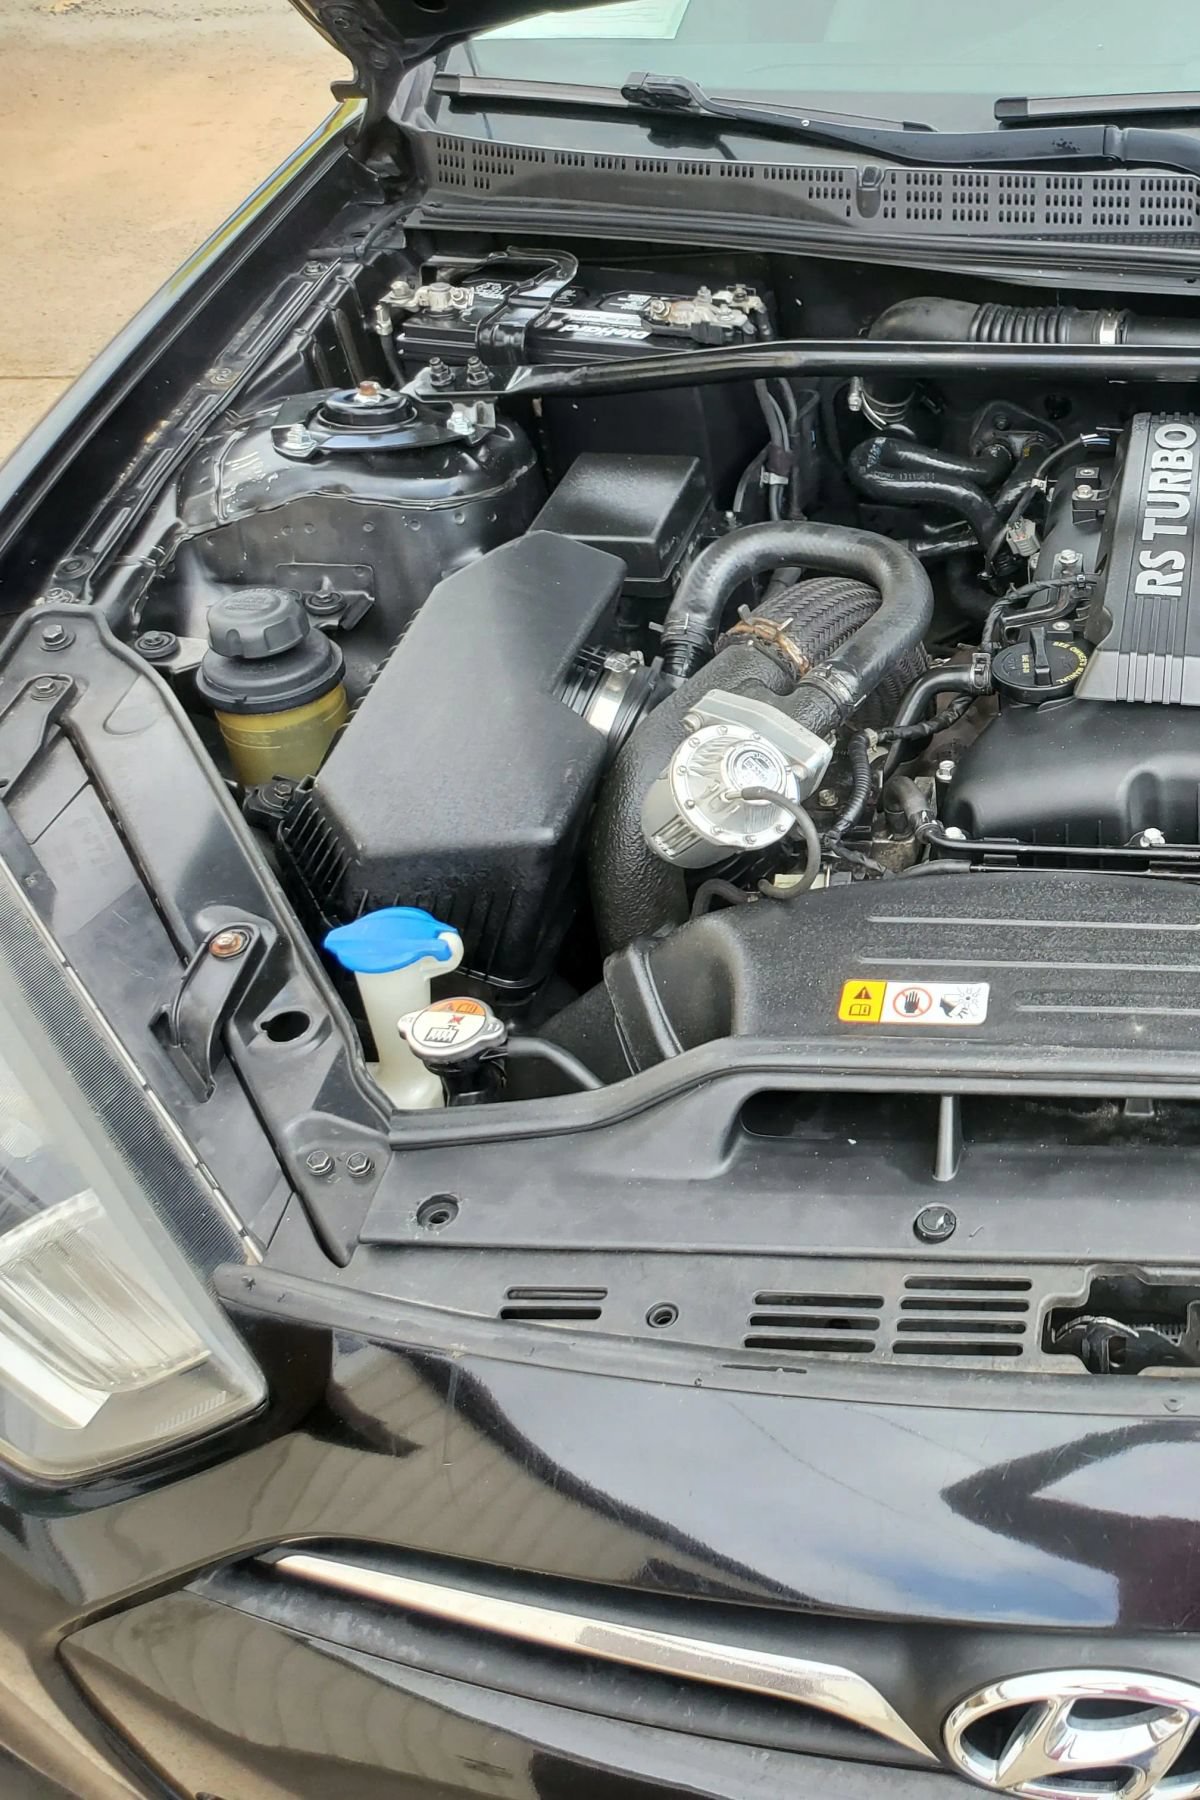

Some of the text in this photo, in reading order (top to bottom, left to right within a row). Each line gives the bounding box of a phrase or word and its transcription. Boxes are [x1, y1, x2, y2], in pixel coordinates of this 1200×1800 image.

[558, 322, 651, 341] DieHard
[1134, 423, 1198, 597] RS TURBO
